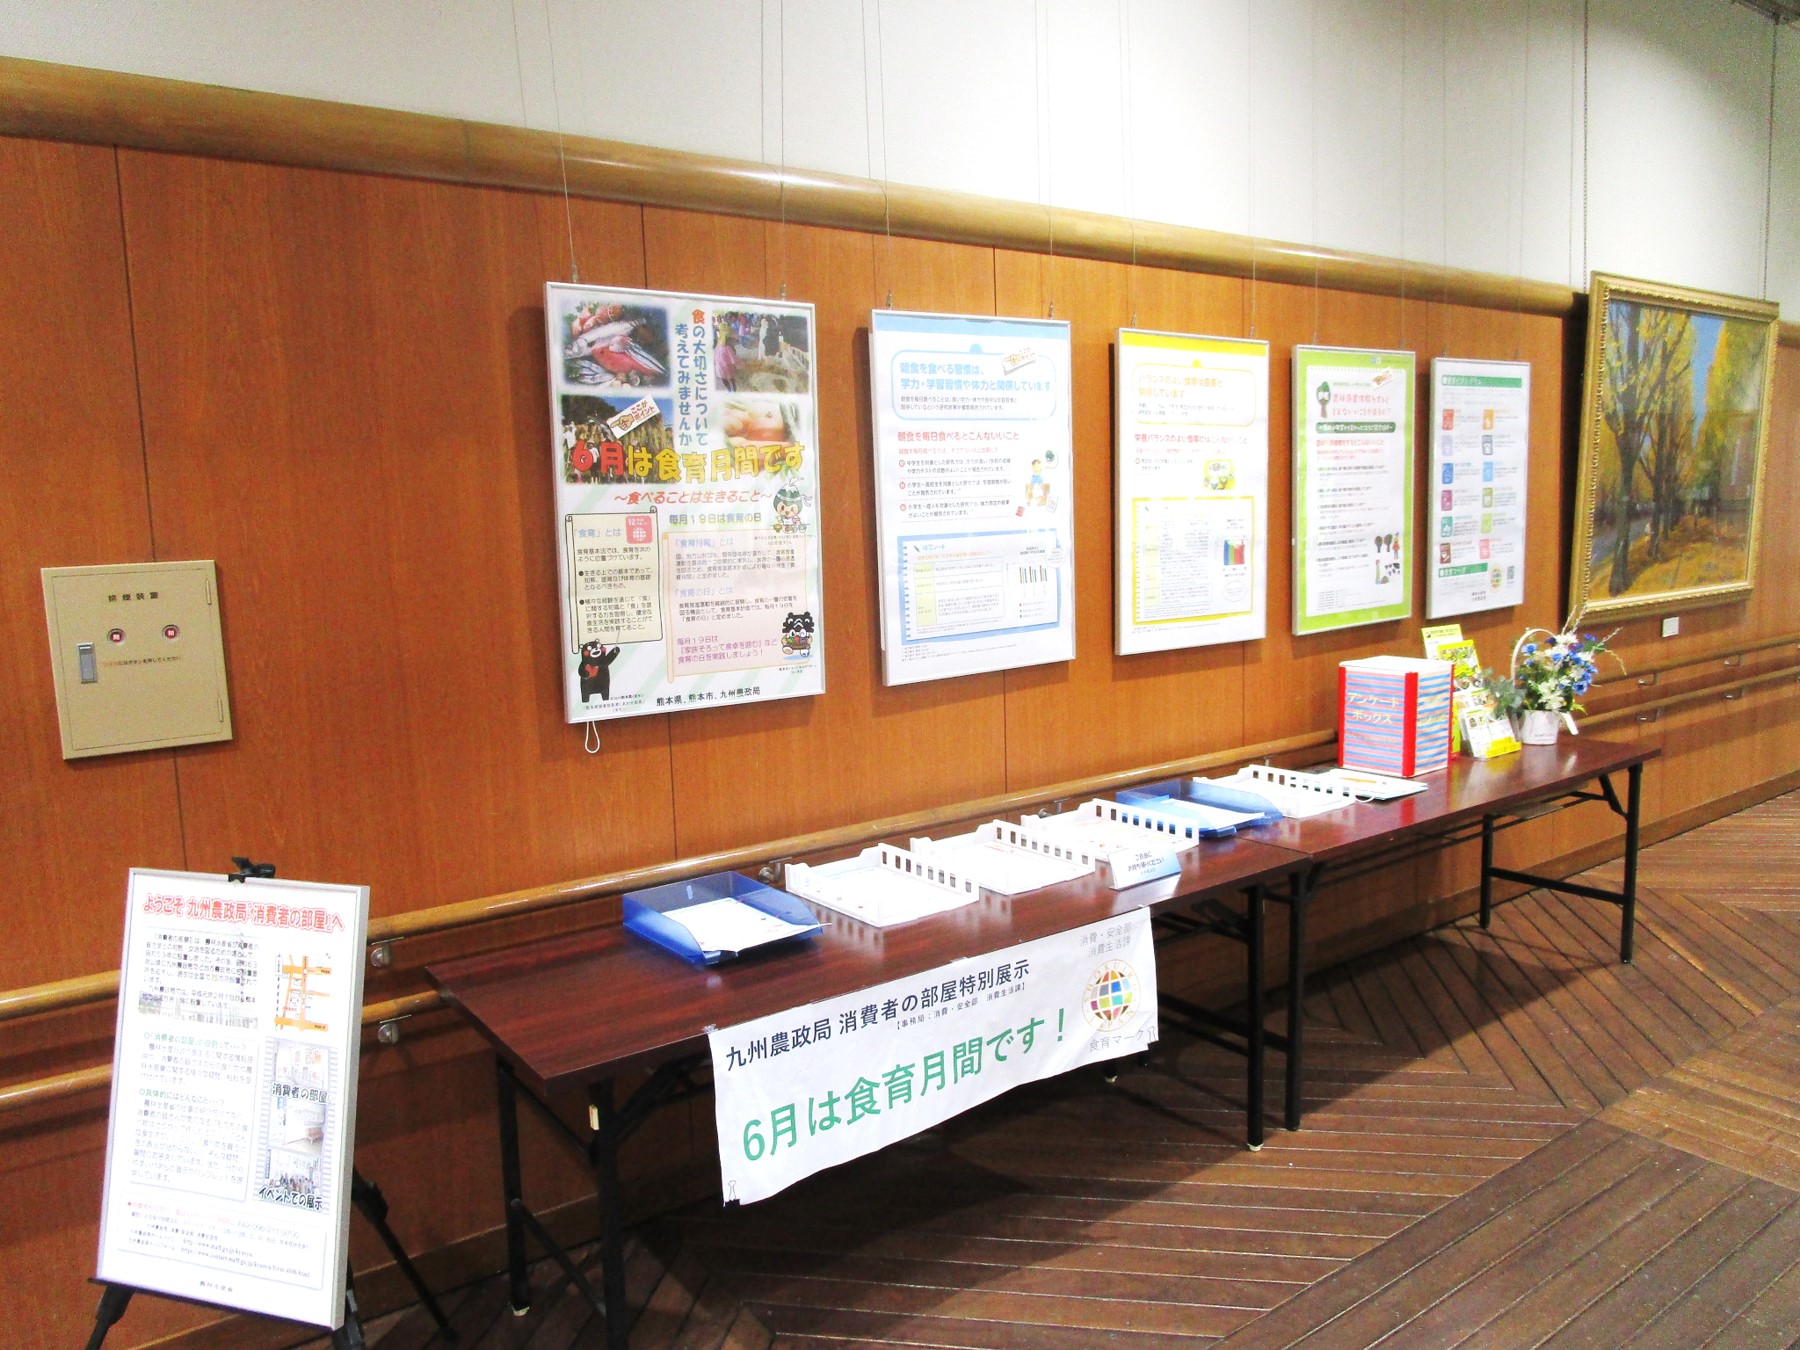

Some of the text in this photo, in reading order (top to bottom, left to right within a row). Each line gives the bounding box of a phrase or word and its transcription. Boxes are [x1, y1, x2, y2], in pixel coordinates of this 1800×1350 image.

[674, 323, 692, 447] 考えてみませんか
[691, 308, 708, 447] 食の大切さについて
[630, 399, 648, 414] ここが
[633, 405, 656, 423] ポイント
[572, 440, 805, 483] 6月は食育月間です
[656, 686, 761, 707] 熊本県、熊本市、九州農政局
[1347, 693, 1400, 709] アンケート
[1352, 711, 1393, 725] ボックス
[143, 894, 184, 915] ようこそ
[1080, 922, 1132, 947] 消費・安全部
[1089, 936, 1131, 958] 消費生活課
[725, 958, 1030, 1072] 九州農政局 消費者の部屋特別展示
[1088, 1029, 1144, 1053] 食育マーク
[742, 1007, 1066, 1162] 6月は食育月間です！
[259, 1186, 323, 1211] イベントでの展示
